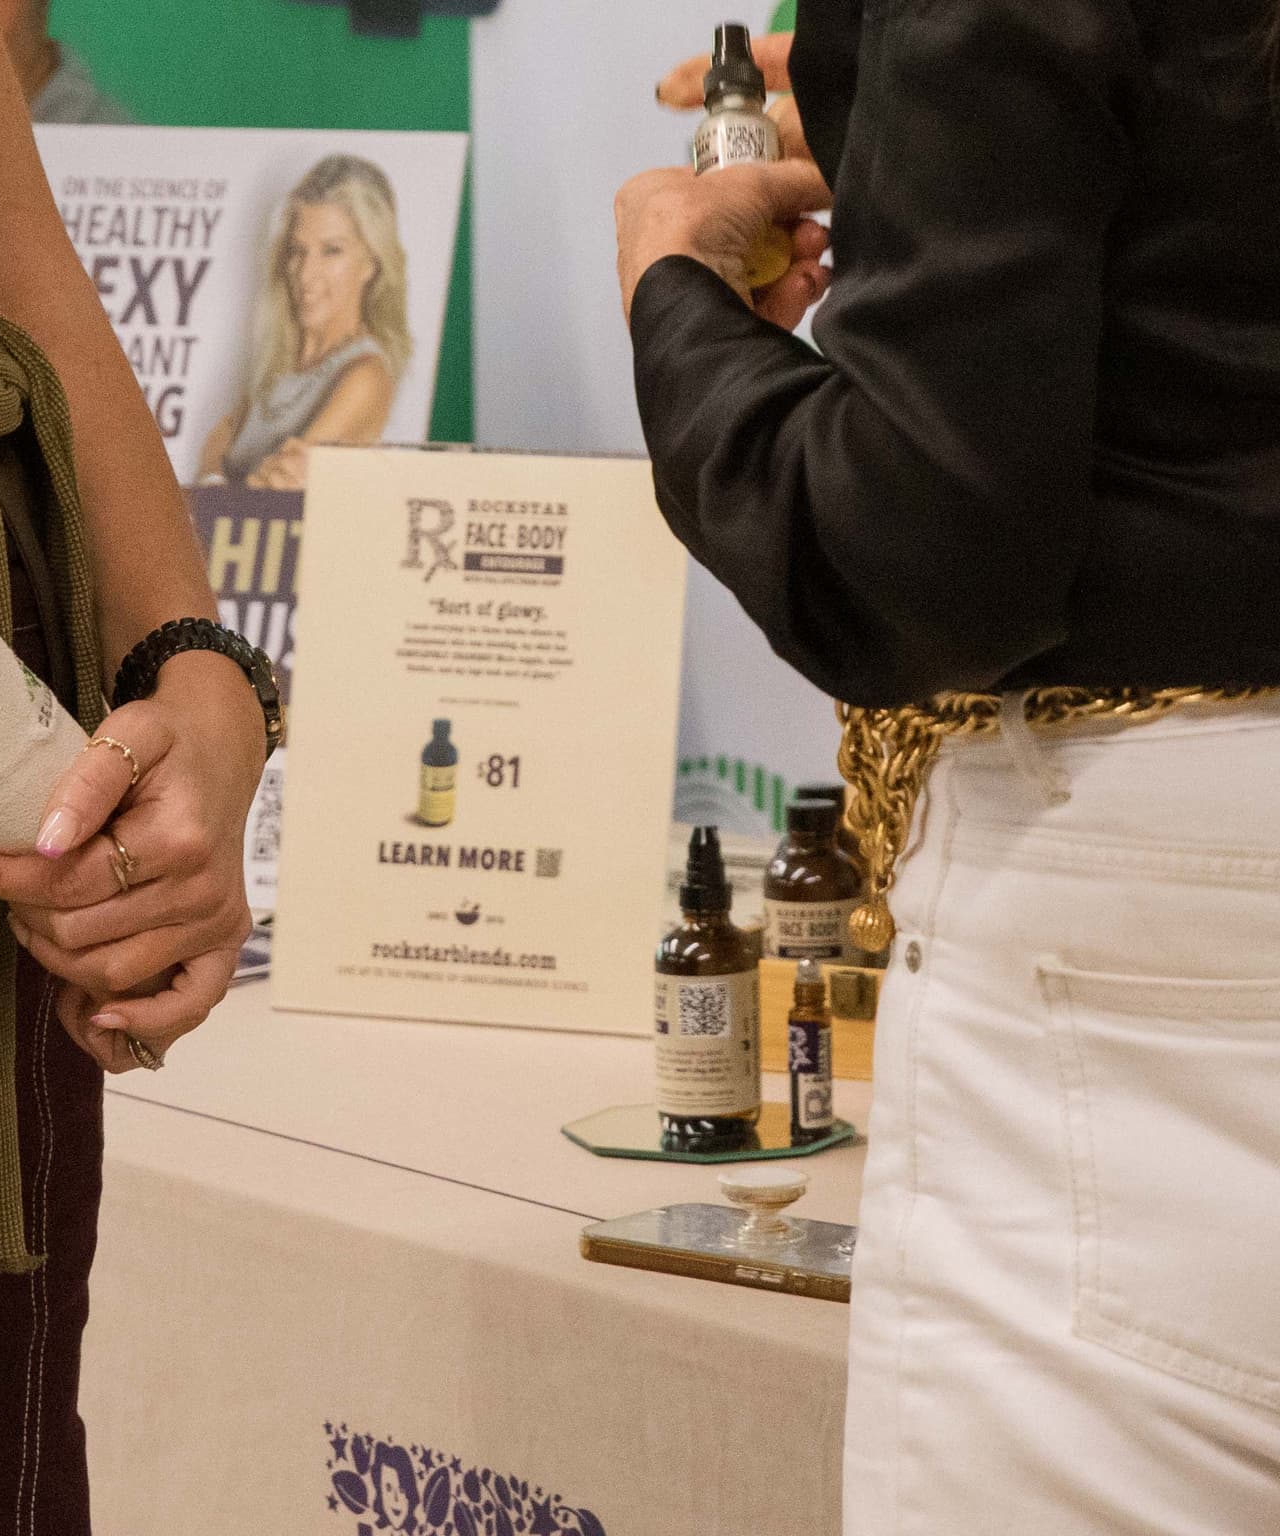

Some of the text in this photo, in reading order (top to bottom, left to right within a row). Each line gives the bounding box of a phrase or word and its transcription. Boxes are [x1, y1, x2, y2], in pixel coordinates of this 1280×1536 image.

[60, 203, 223, 250] HEALTHY
[88, 254, 215, 327] EXY
[378, 840, 527, 872] LEARN MORE
[371, 941, 557, 971] rockstarblends.com
